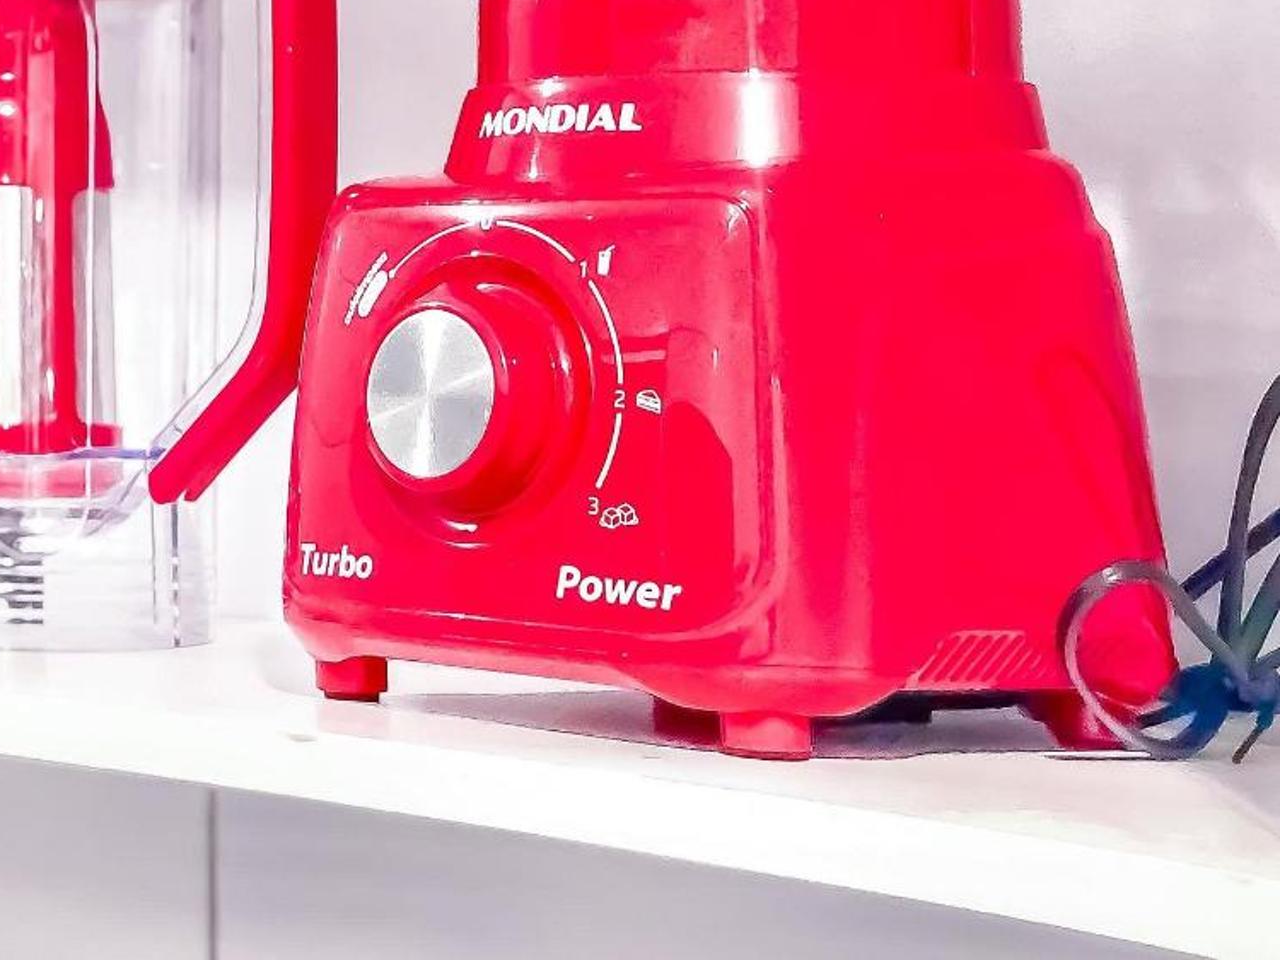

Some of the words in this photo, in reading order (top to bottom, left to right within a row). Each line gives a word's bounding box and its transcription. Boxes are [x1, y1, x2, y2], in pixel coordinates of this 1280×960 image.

[478, 102, 643, 139] MONDIAL
[579, 259, 588, 279] 1
[613, 389, 626, 410] 2
[587, 496, 600, 516] 3
[300, 542, 374, 580] Turbo
[555, 564, 683, 612] Power
